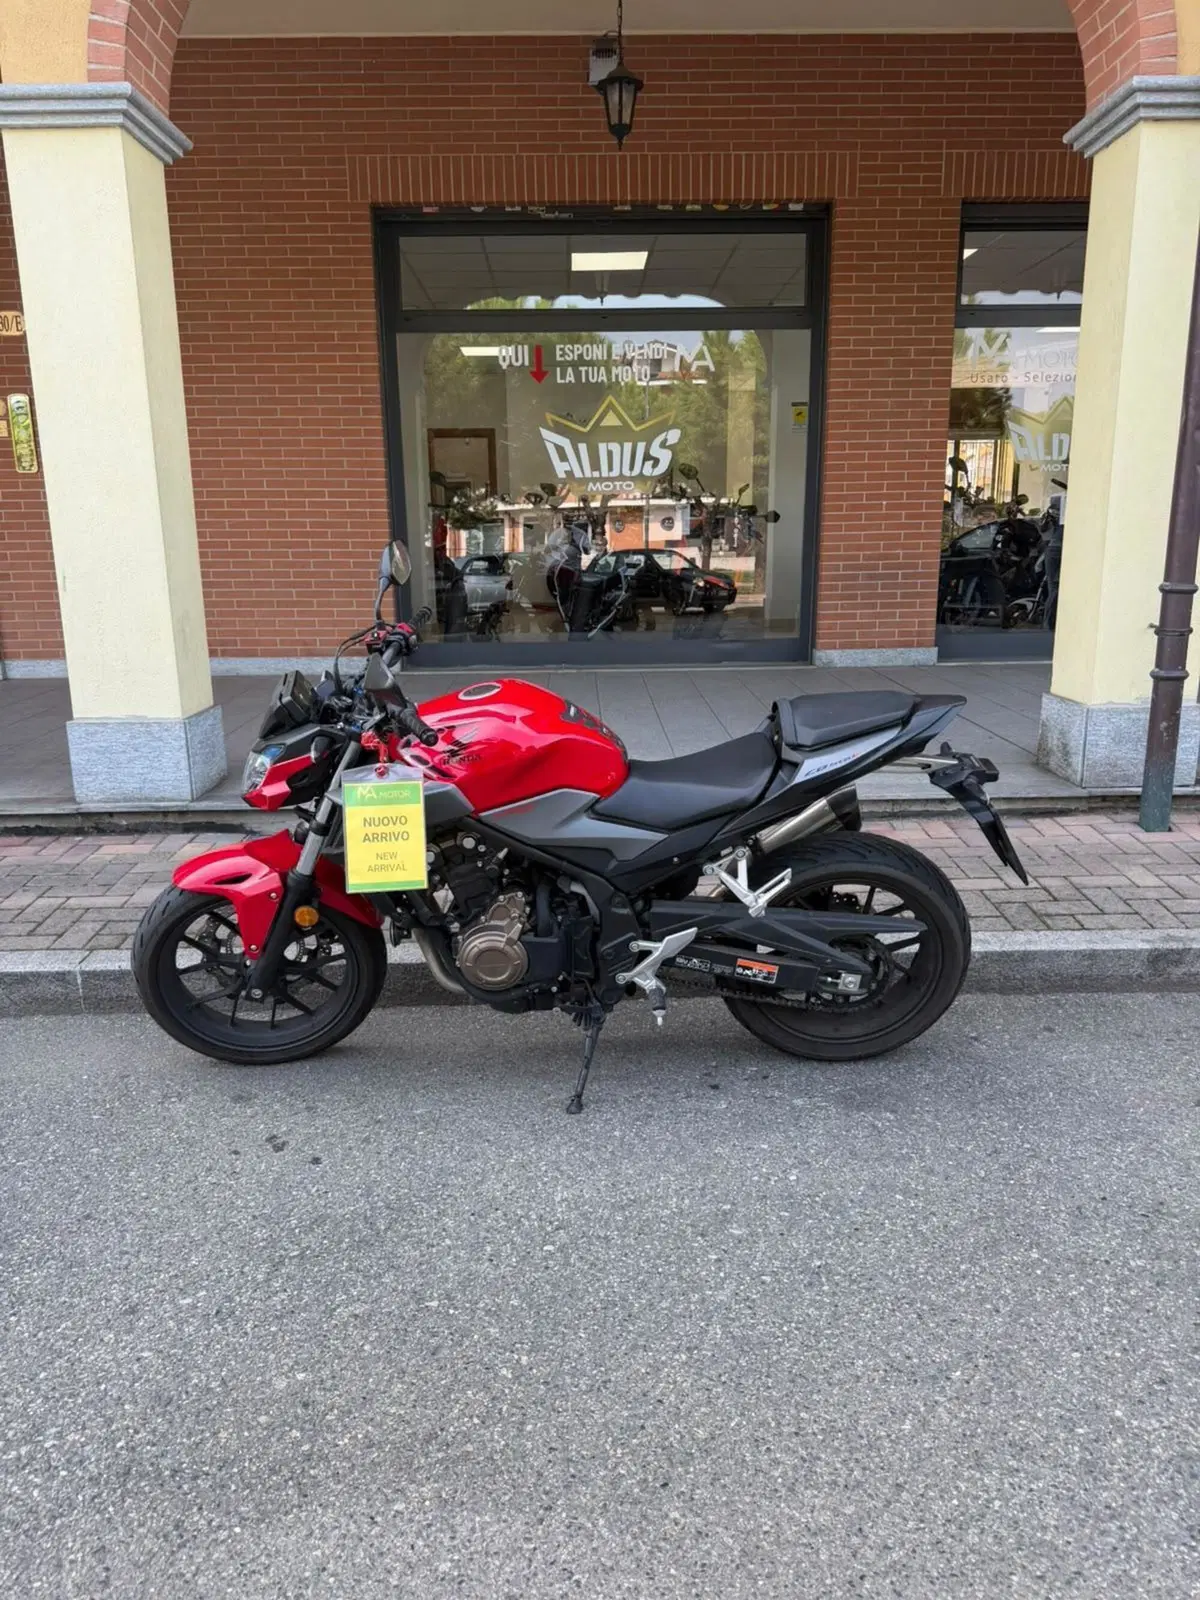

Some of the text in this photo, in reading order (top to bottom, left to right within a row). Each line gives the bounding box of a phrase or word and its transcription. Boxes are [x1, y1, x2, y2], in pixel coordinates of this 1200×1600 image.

[498, 344, 529, 369] QUI
[555, 343, 669, 361] ESPONI E VENDI
[556, 365, 650, 384] LA TUA MOTO
[538, 426, 682, 479] ALDUS
[587, 480, 635, 492] MOTO
[362, 815, 409, 828] NUOVO
[362, 830, 410, 843] ARRIVO
[375, 851, 399, 861] NEW
[366, 863, 408, 873] ARRIVAL
